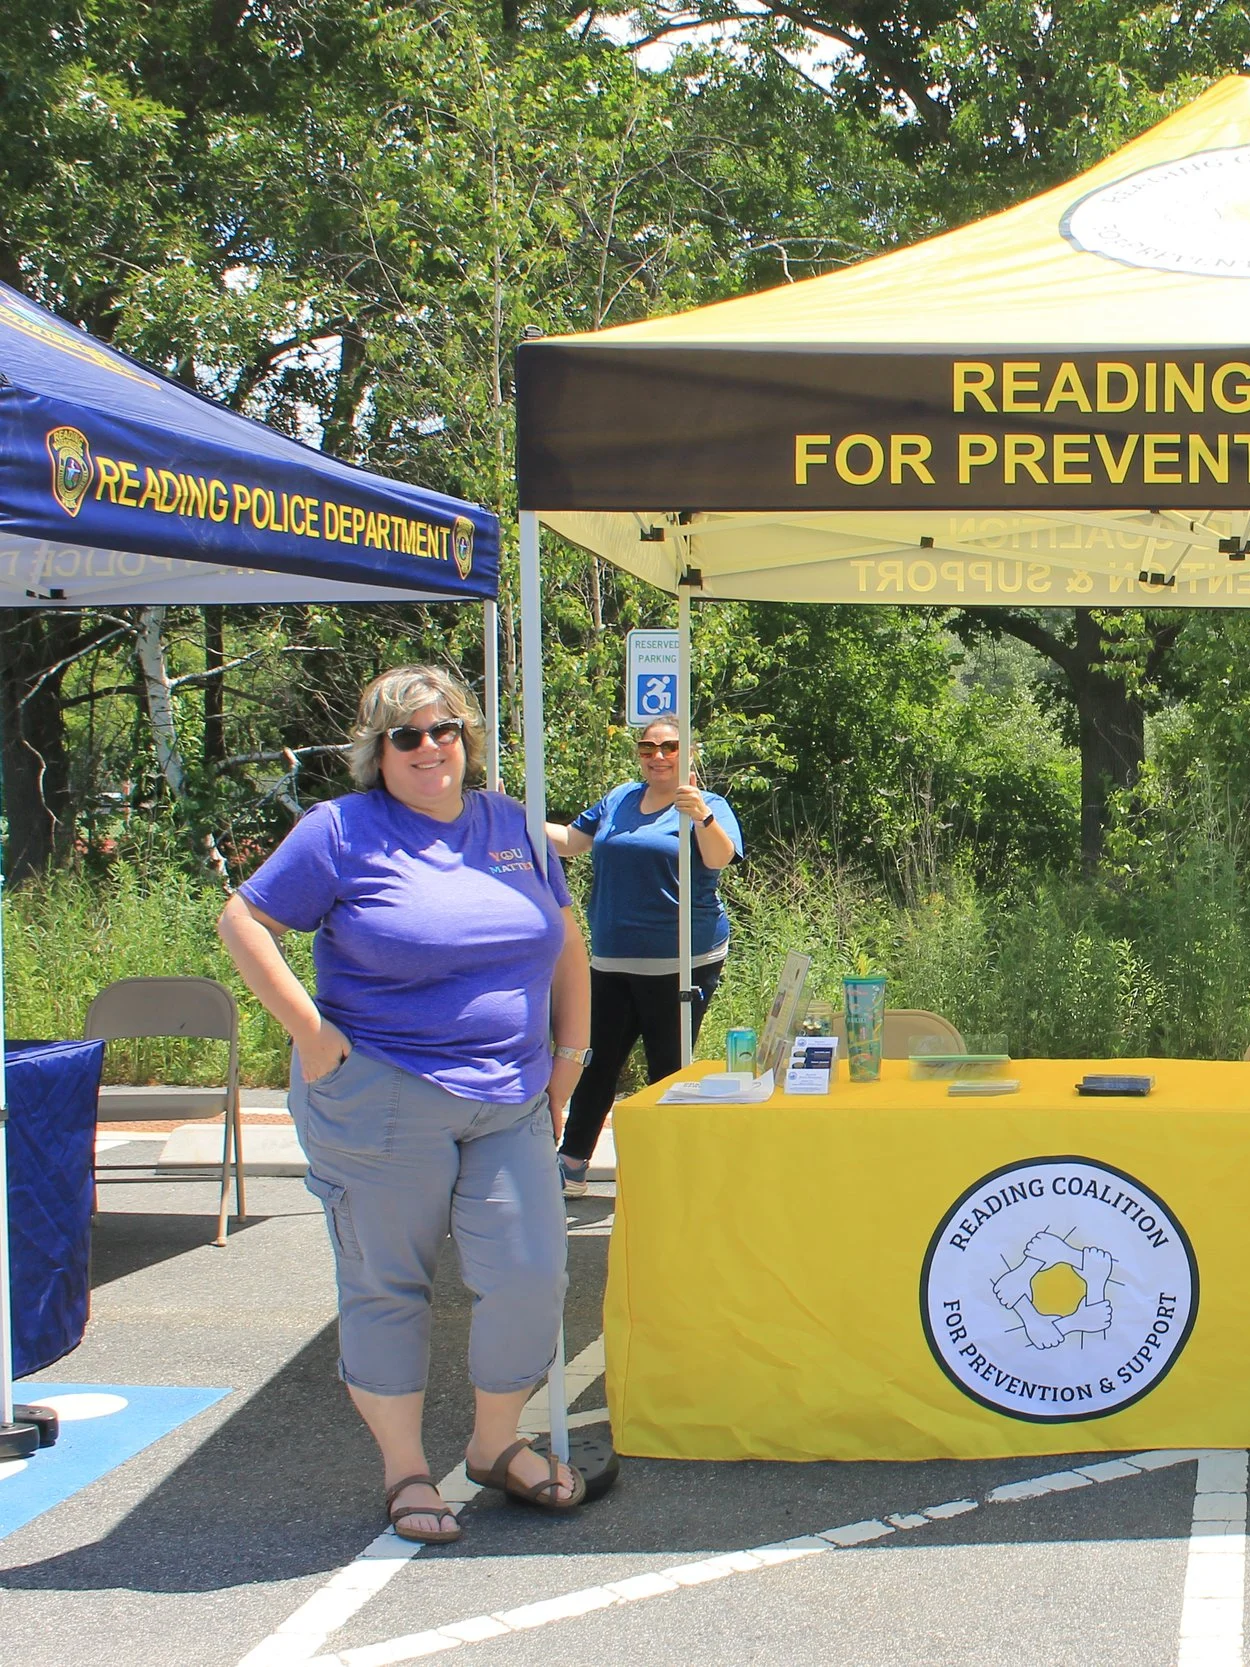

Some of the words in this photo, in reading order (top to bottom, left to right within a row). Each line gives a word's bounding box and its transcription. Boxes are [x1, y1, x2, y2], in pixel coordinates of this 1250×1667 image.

[795, 434, 935, 485] FOR
[95, 456, 228, 522] READING
[231, 483, 320, 538] POLICE
[324, 501, 451, 562] DEPARTMENT
[635, 640, 680, 649] RESERVED
[638, 655, 677, 663] PARKING
[950, 1178, 1045, 1251] READING
[1052, 1177, 1169, 1248] COALITION
[944, 1299, 968, 1344] FOR
[959, 1343, 1093, 1402] PREVENTION
[1100, 1378, 1115, 1393] &
[1117, 1292, 1176, 1383] SUPPORT
